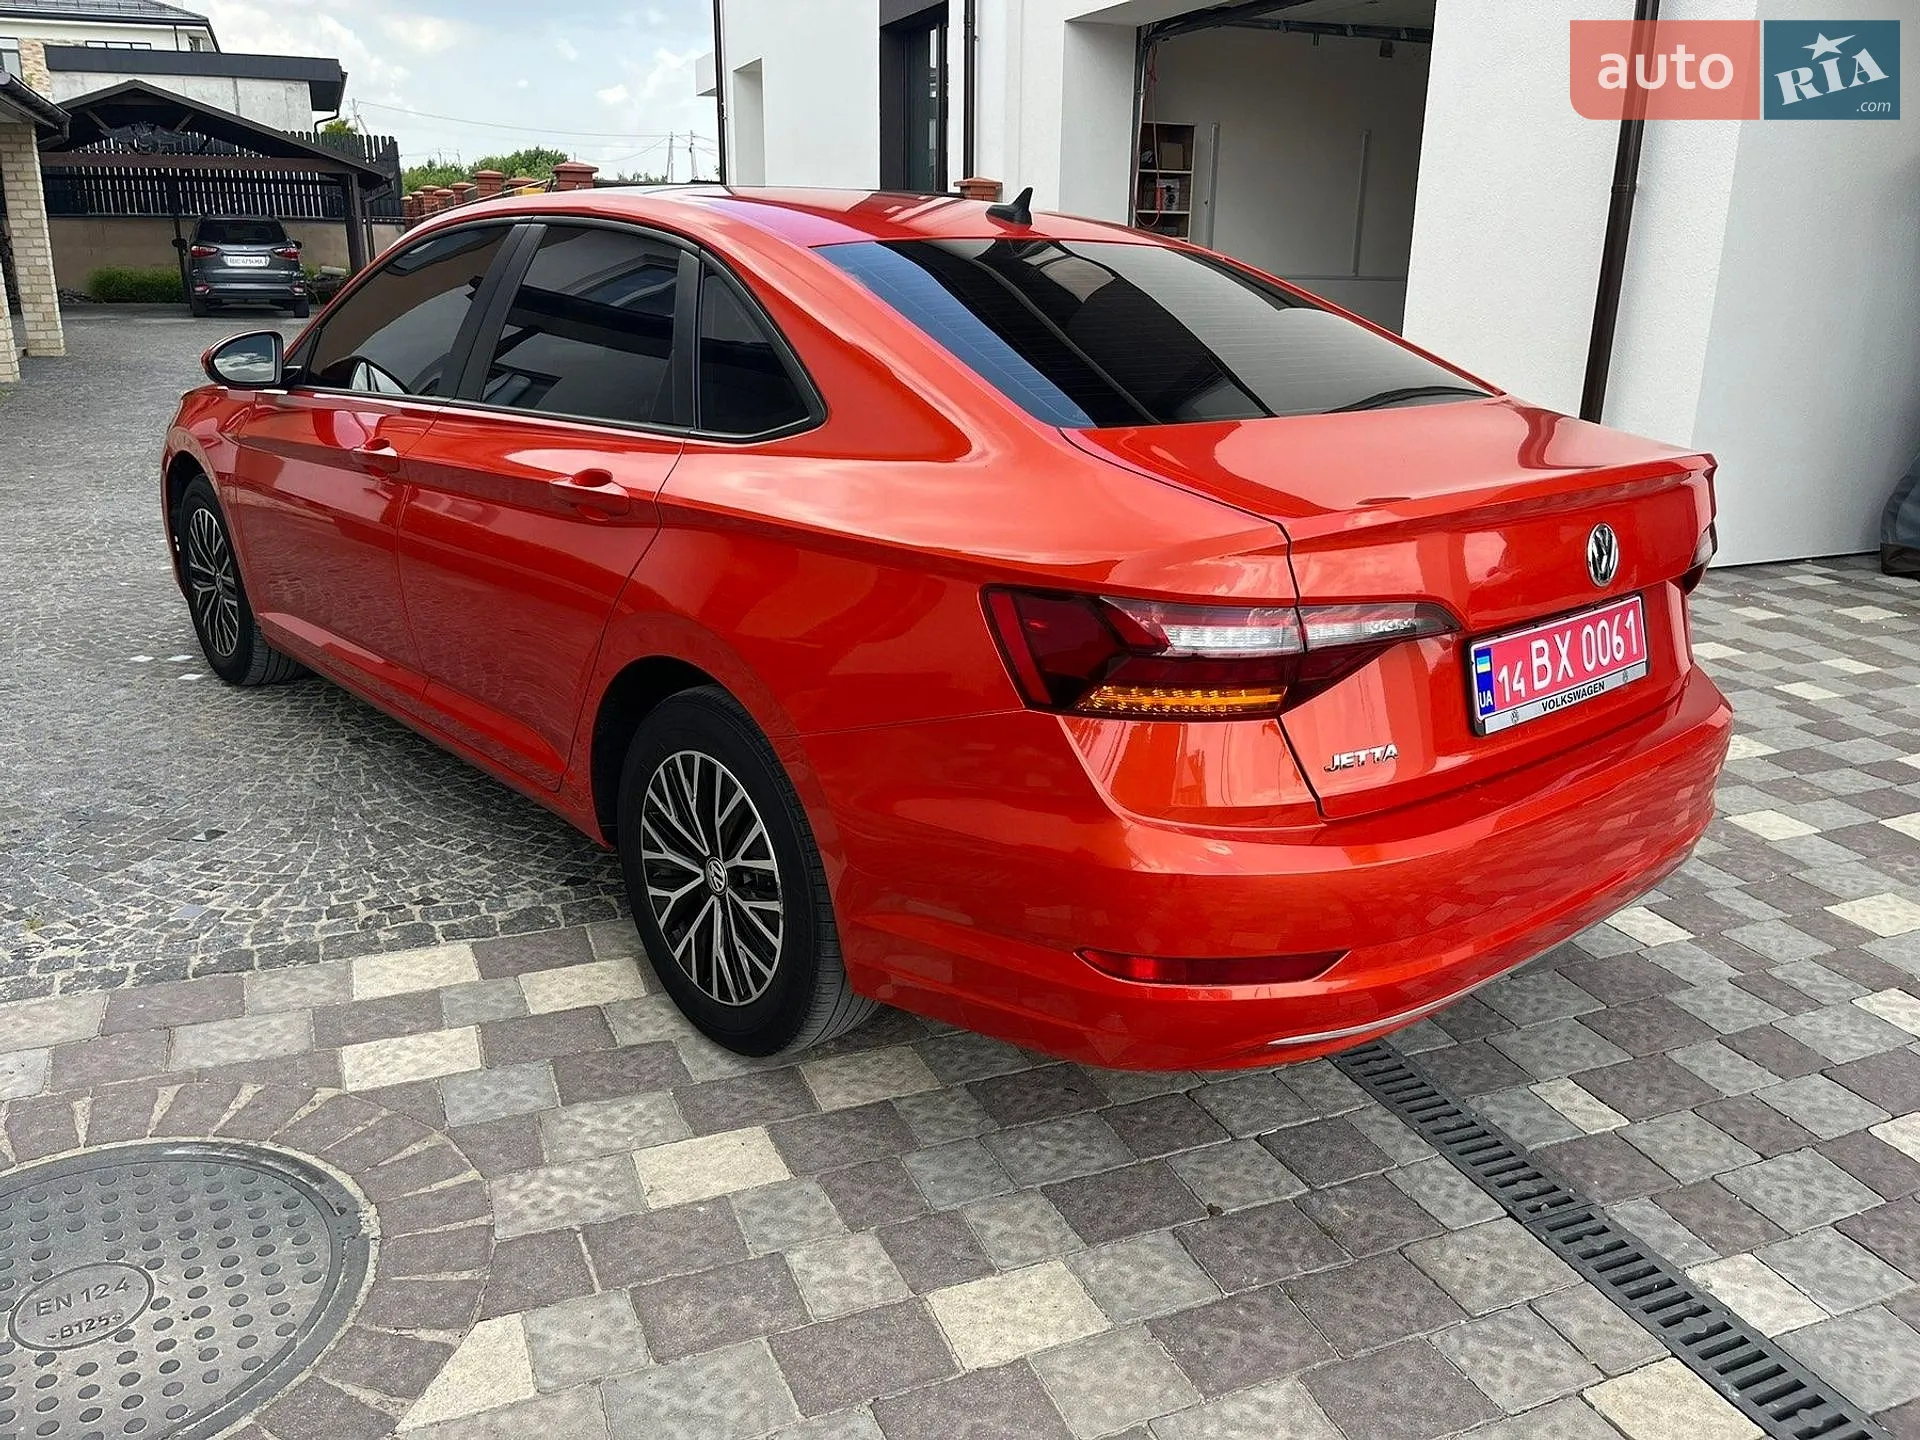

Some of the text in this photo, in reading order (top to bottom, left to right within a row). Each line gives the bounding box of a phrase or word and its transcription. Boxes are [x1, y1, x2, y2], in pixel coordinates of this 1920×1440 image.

[1581, 609, 1638, 673] 0061
[1479, 690, 1494, 708] UA
[1541, 681, 1605, 712] VOLKSWAGEN
[1323, 743, 1399, 772] JETTA
[36, 1277, 131, 1317] EN 124
